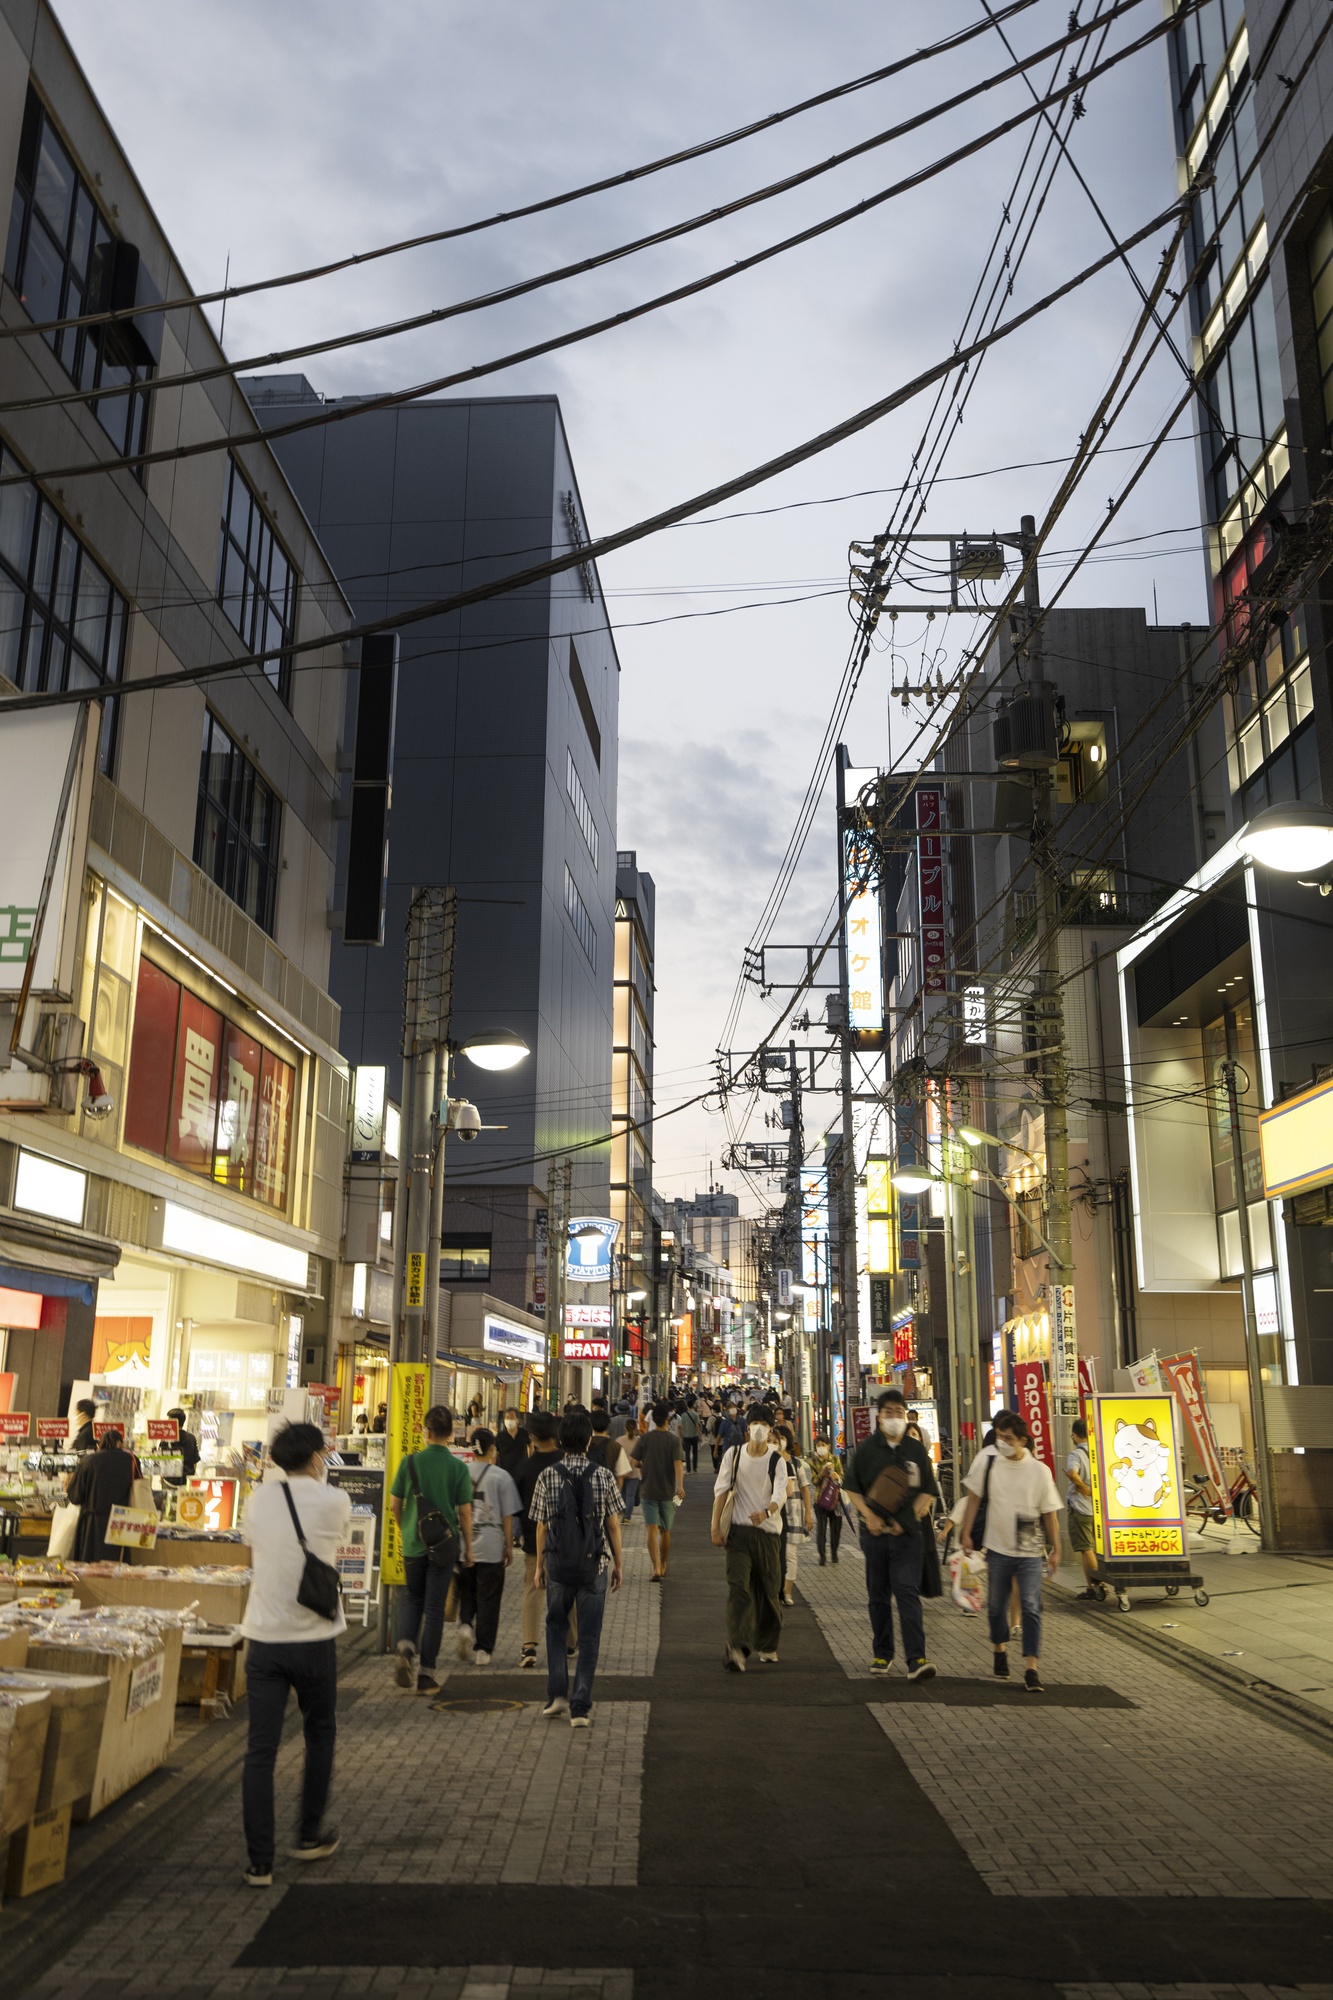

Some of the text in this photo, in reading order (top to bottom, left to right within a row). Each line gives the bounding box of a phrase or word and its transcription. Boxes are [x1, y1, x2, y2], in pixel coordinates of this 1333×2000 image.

[922, 811, 942, 912] ノーブル
[178, 1027, 254, 1168] 買取
[263, 1074, 290, 1110] パソコン
[360, 1152, 373, 1161] 2F
[567, 1264, 611, 1276] STATION
[1063, 1310, 1075, 1371] 片岡質店
[184, 1502, 199, 1517] 豆
[1114, 1530, 1178, 1539] フード&ドリンク
[1114, 1541, 1179, 1553] 持ち込みOK
